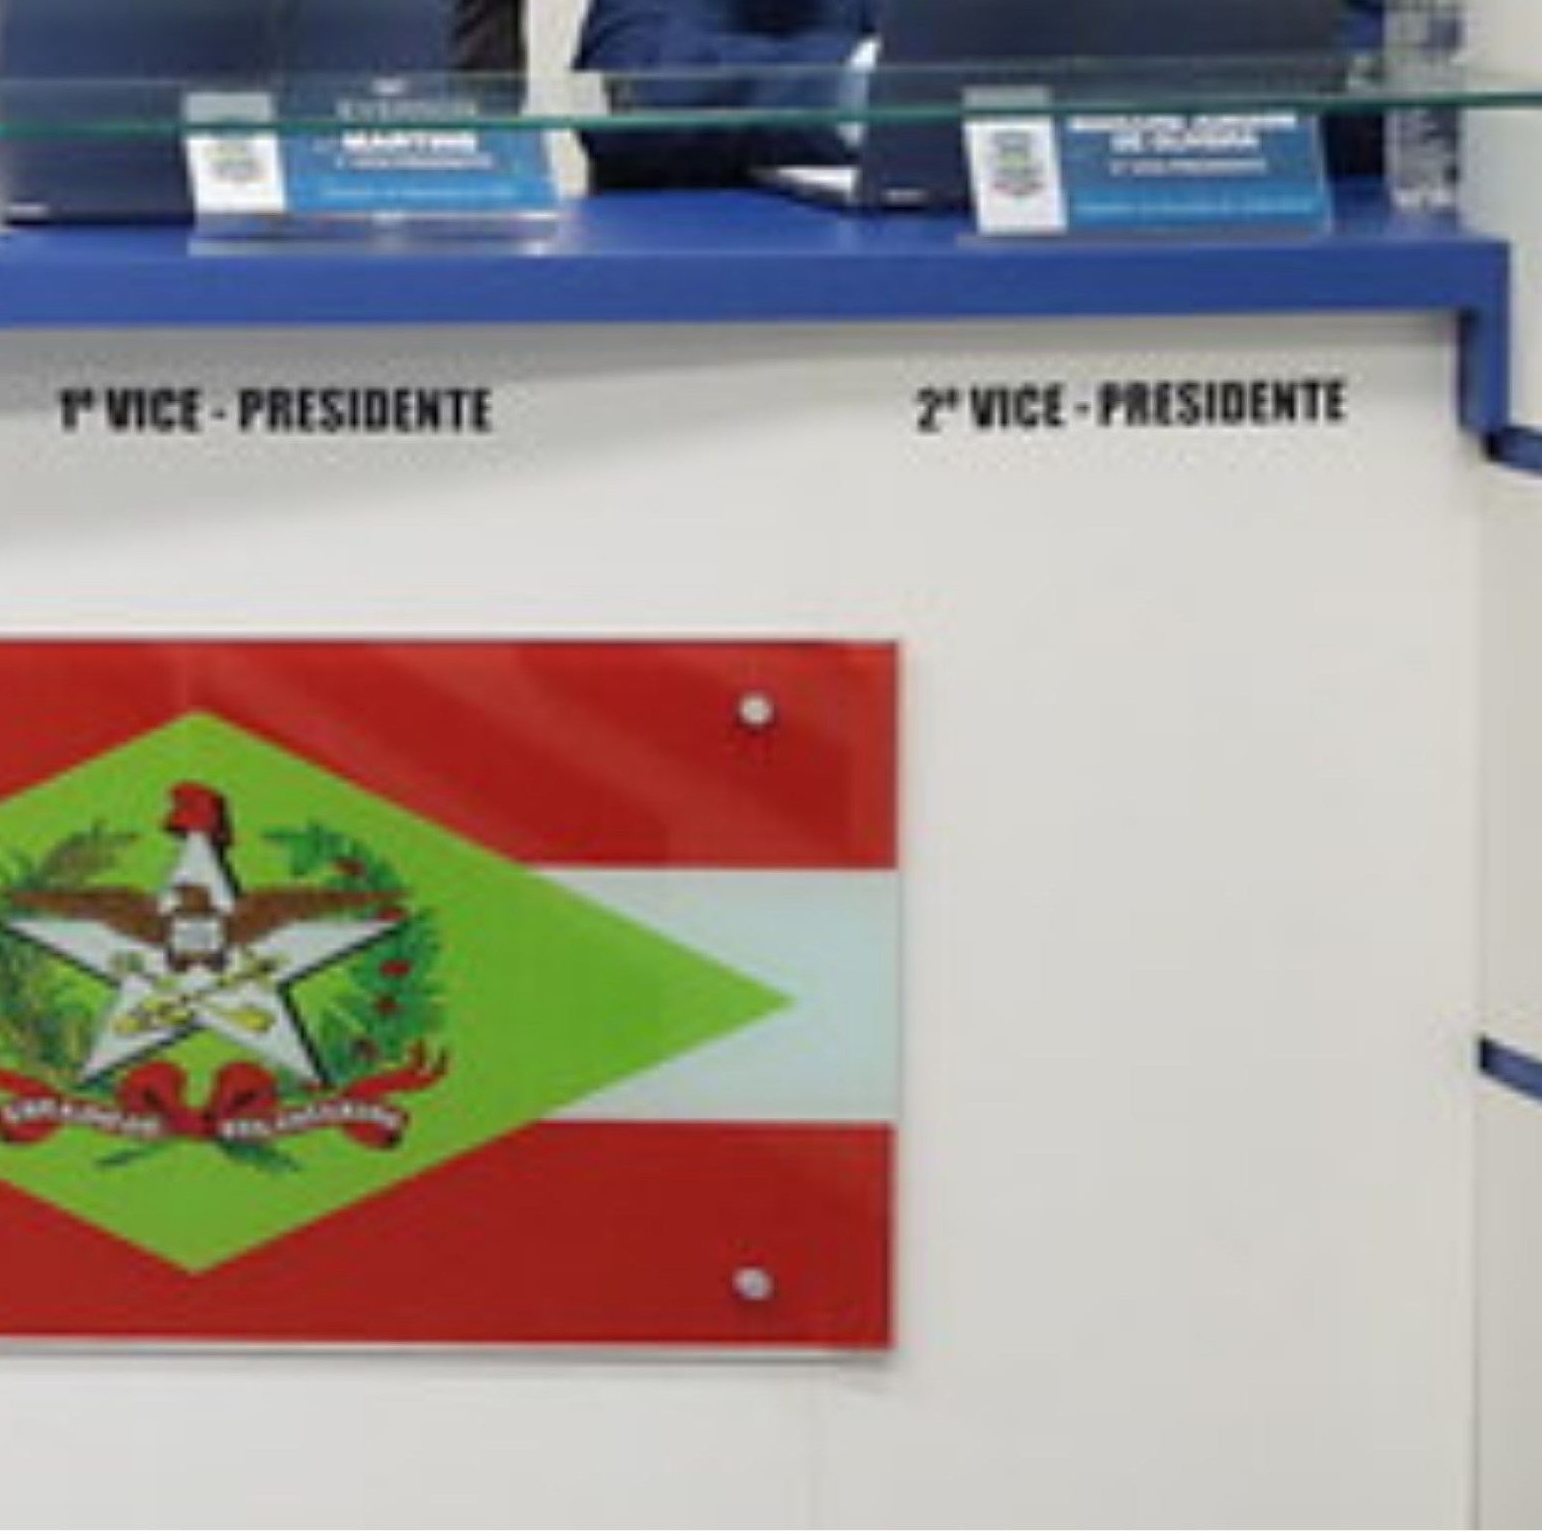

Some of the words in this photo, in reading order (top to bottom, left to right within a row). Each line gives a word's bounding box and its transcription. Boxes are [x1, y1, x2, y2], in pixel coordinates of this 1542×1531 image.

[103, 386, 203, 434] VICE
[236, 385, 492, 434] PRESIDENTE
[969, 382, 1064, 429] VICE
[1097, 378, 1346, 426] PRESIDENTE
